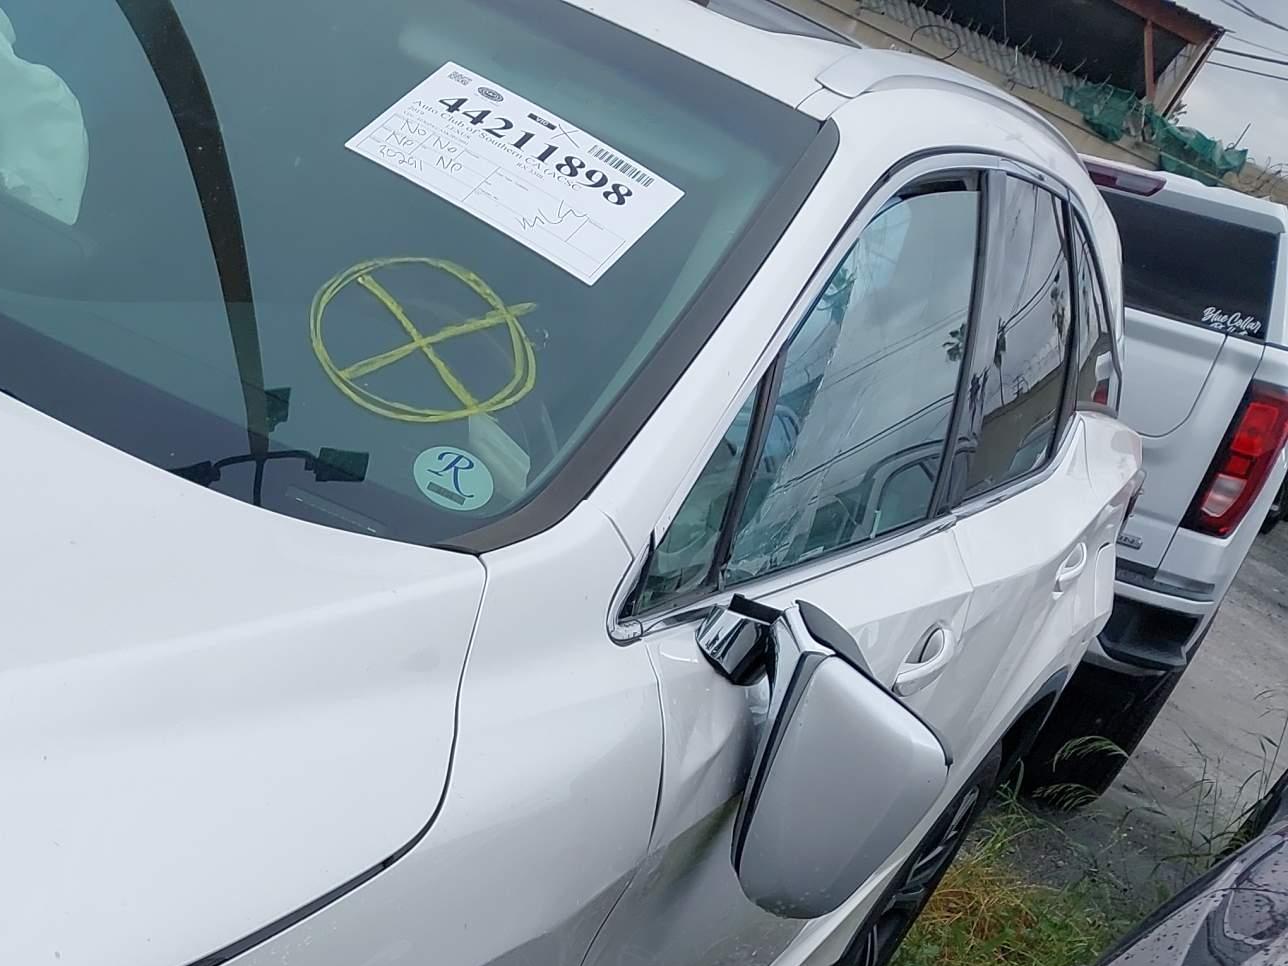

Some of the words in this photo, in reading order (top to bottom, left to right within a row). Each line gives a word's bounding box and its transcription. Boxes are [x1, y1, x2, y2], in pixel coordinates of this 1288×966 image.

[412, 100, 439, 114] Auto
[440, 112, 465, 127] Club
[479, 131, 523, 159] Southern
[524, 157, 541, 170] CA
[543, 168, 583, 191] (ACSC
[438, 97, 633, 206] 44211898
[1202, 306, 1228, 323] Blue
[1227, 312, 1262, 334] Collar
[427, 451, 475, 498] R
